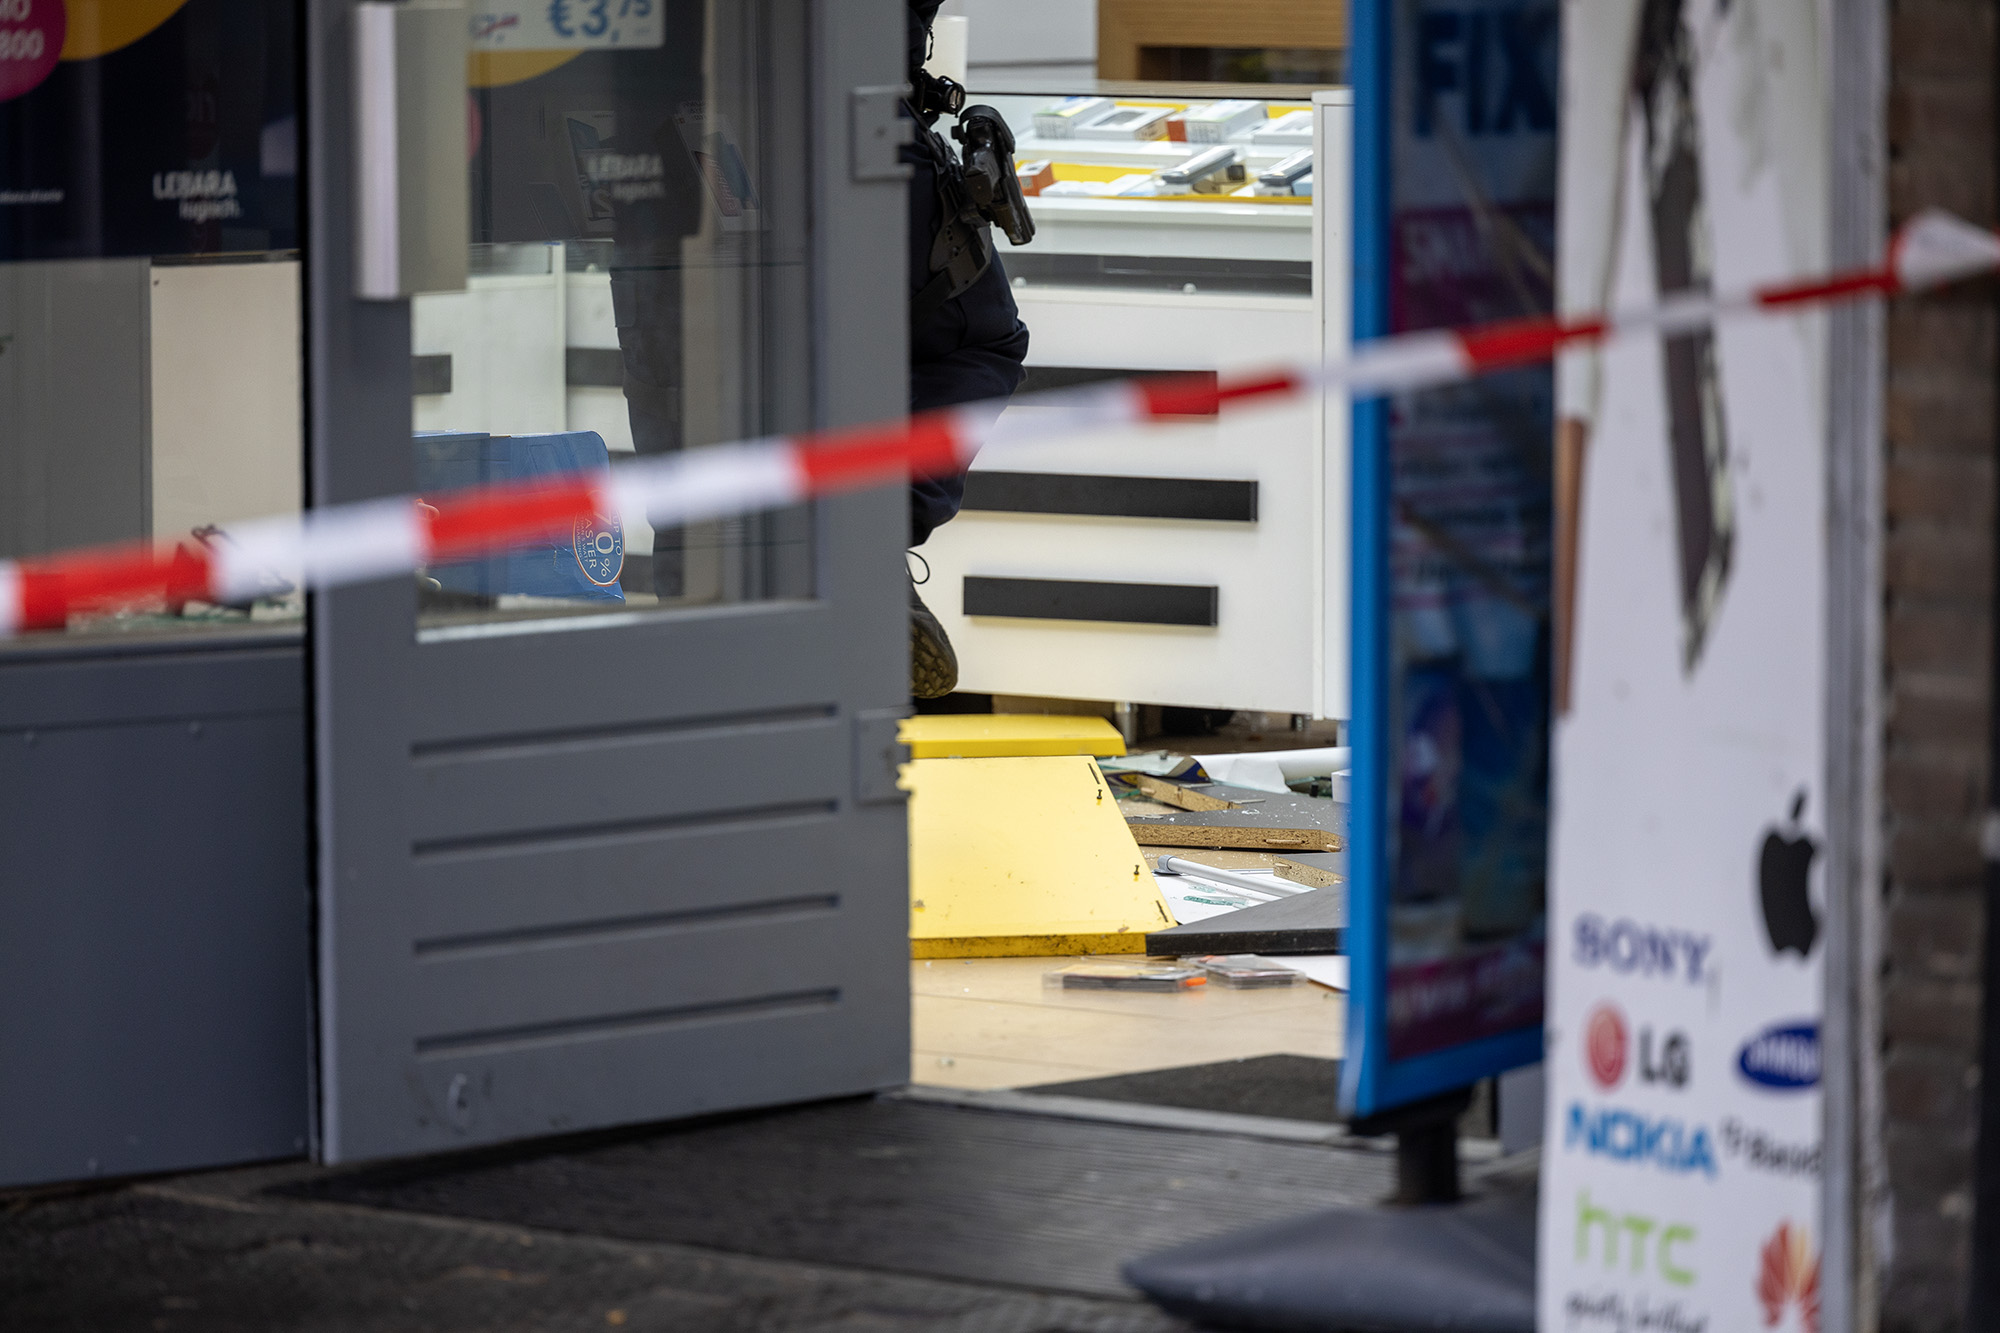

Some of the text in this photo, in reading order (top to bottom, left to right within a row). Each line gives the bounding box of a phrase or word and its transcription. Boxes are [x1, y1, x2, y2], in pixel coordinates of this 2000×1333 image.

[585, 512, 597, 569] ASTER
[614, 537, 622, 556] TO
[1572, 912, 1711, 984] SONY
[1639, 1026, 1691, 1089] LG
[1565, 1100, 1717, 1178] NOKIA
